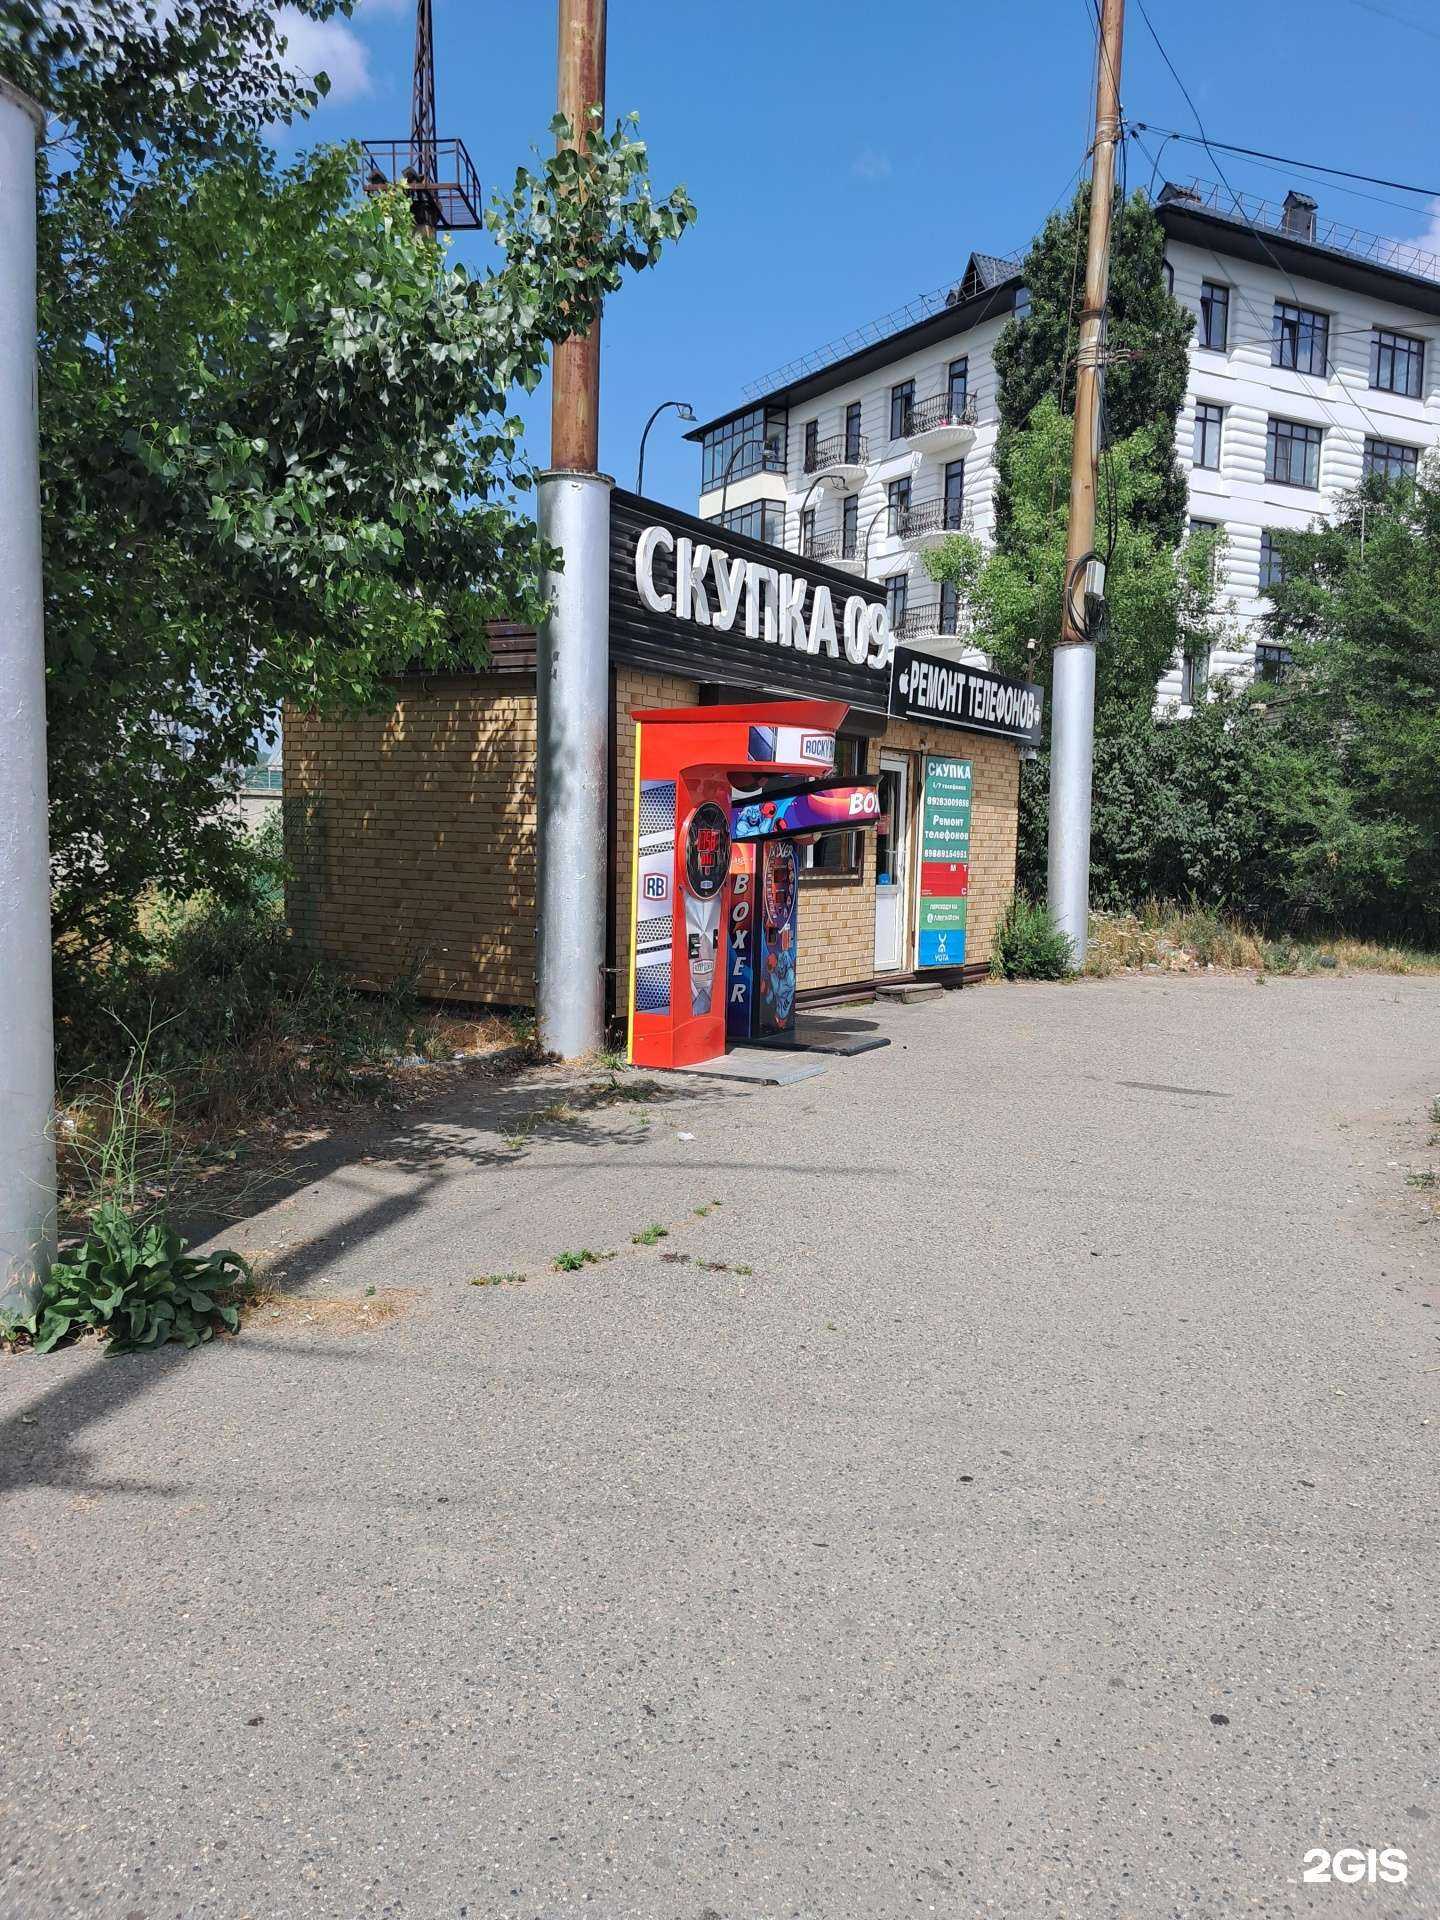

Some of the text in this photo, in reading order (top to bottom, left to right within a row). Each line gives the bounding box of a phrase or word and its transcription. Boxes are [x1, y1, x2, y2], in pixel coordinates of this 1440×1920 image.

[636, 526, 890, 669] СКУПКА 09
[908, 660, 1035, 729] РЕМОНТ ТЕЛЕФОНОВ
[928, 762, 971, 779] СКУПКА
[932, 814, 964, 826] Ремонт
[925, 830, 969, 842] телефонов
[647, 877, 664, 897] RB
